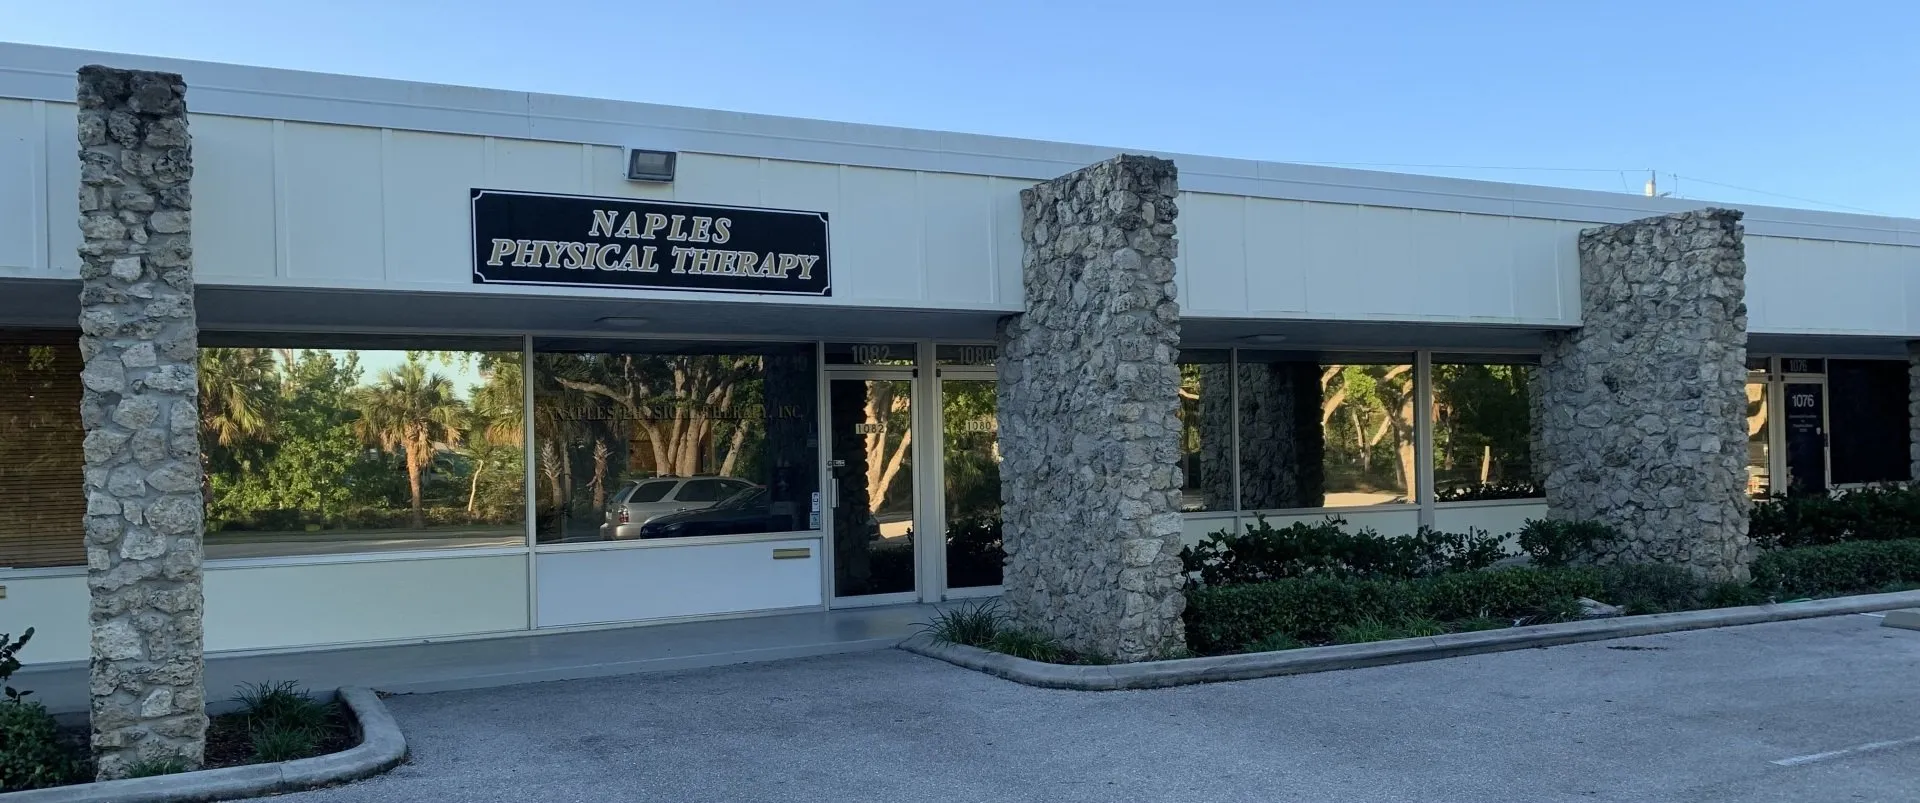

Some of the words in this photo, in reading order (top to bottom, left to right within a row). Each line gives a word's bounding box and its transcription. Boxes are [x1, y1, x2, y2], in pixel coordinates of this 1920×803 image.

[588, 209, 732, 244] NAPLES
[487, 238, 659, 273] PHYSICAL
[671, 246, 820, 280] THERAPY
[851, 345, 891, 366] 1082
[1789, 359, 1808, 372] 1076
[1791, 394, 1815, 408] 1076
[619, 404, 697, 421] PHSIC
[857, 423, 885, 434] 1082
[966, 421, 992, 431] 1080
